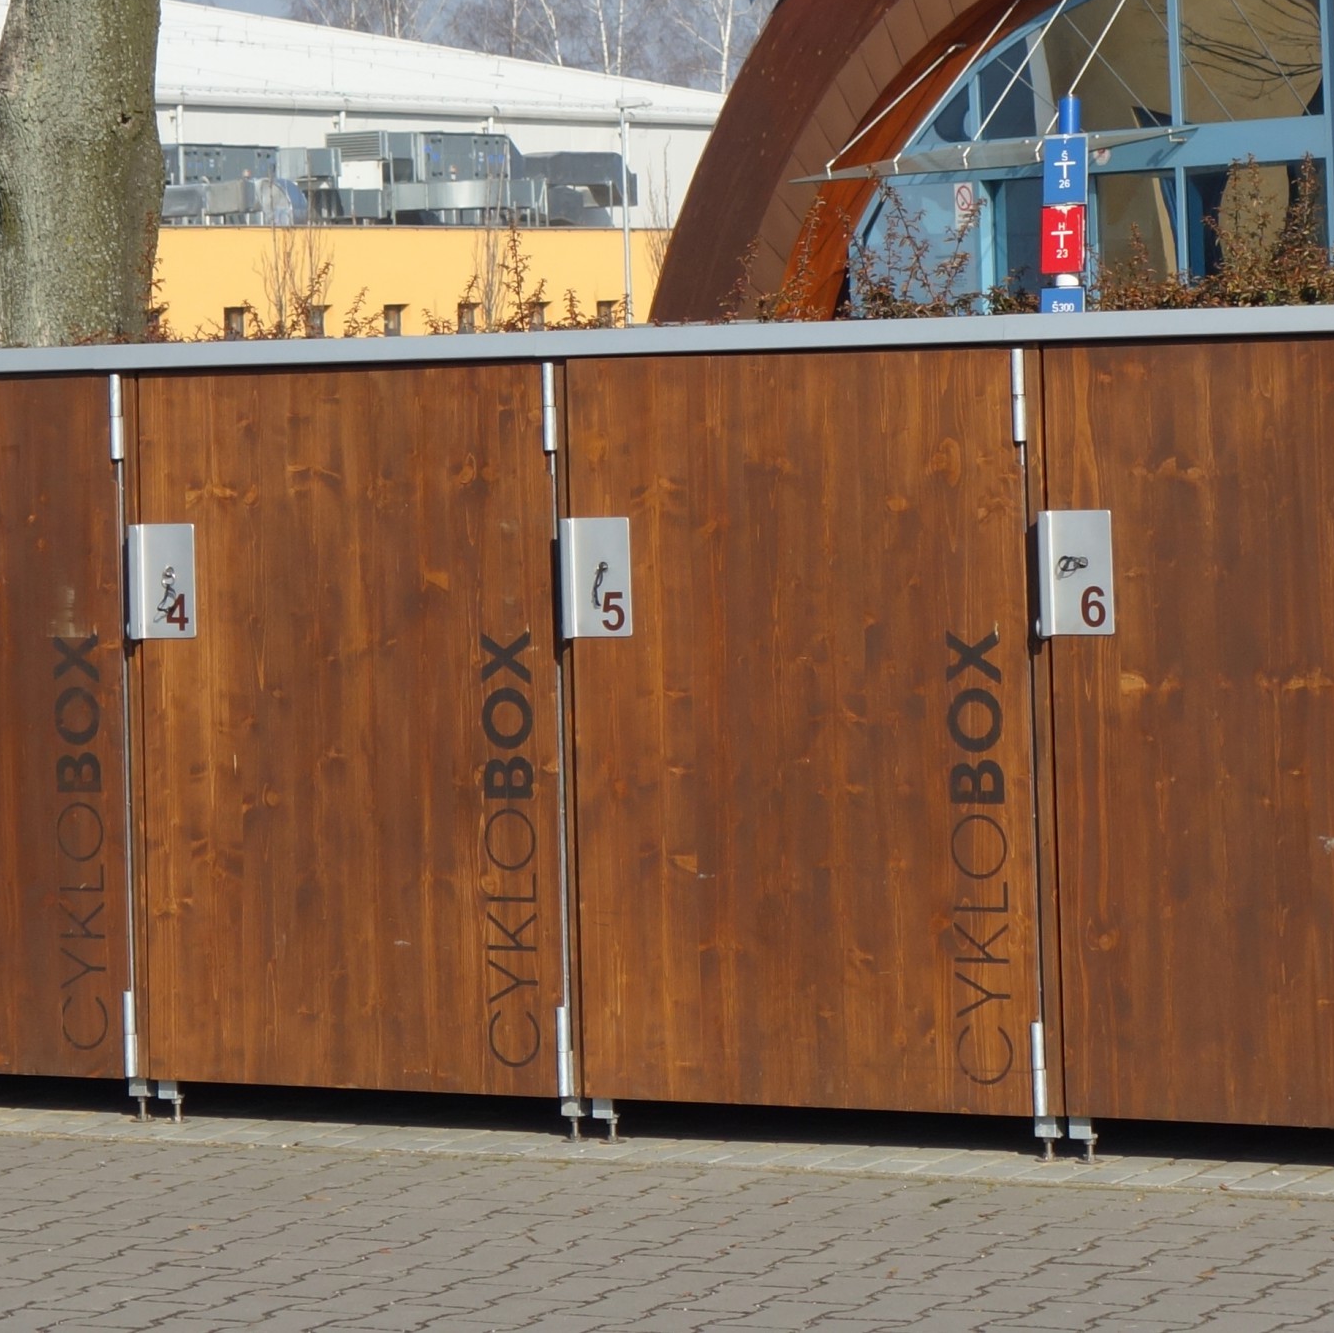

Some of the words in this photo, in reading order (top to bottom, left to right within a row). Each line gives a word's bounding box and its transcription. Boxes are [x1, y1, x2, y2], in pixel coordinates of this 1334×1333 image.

[1058, 179, 1071, 189] 26
[1058, 222, 1066, 231] H
[1056, 249, 1069, 259] 23
[166, 593, 189, 631] 4
[602, 592, 625, 631] 5
[1081, 586, 1106, 627] 6
[53, 634, 109, 1051] CYKLOBOX
[480, 631, 540, 1067] CYKLOBOX
[946, 628, 1013, 1085] CYKLOBOX
